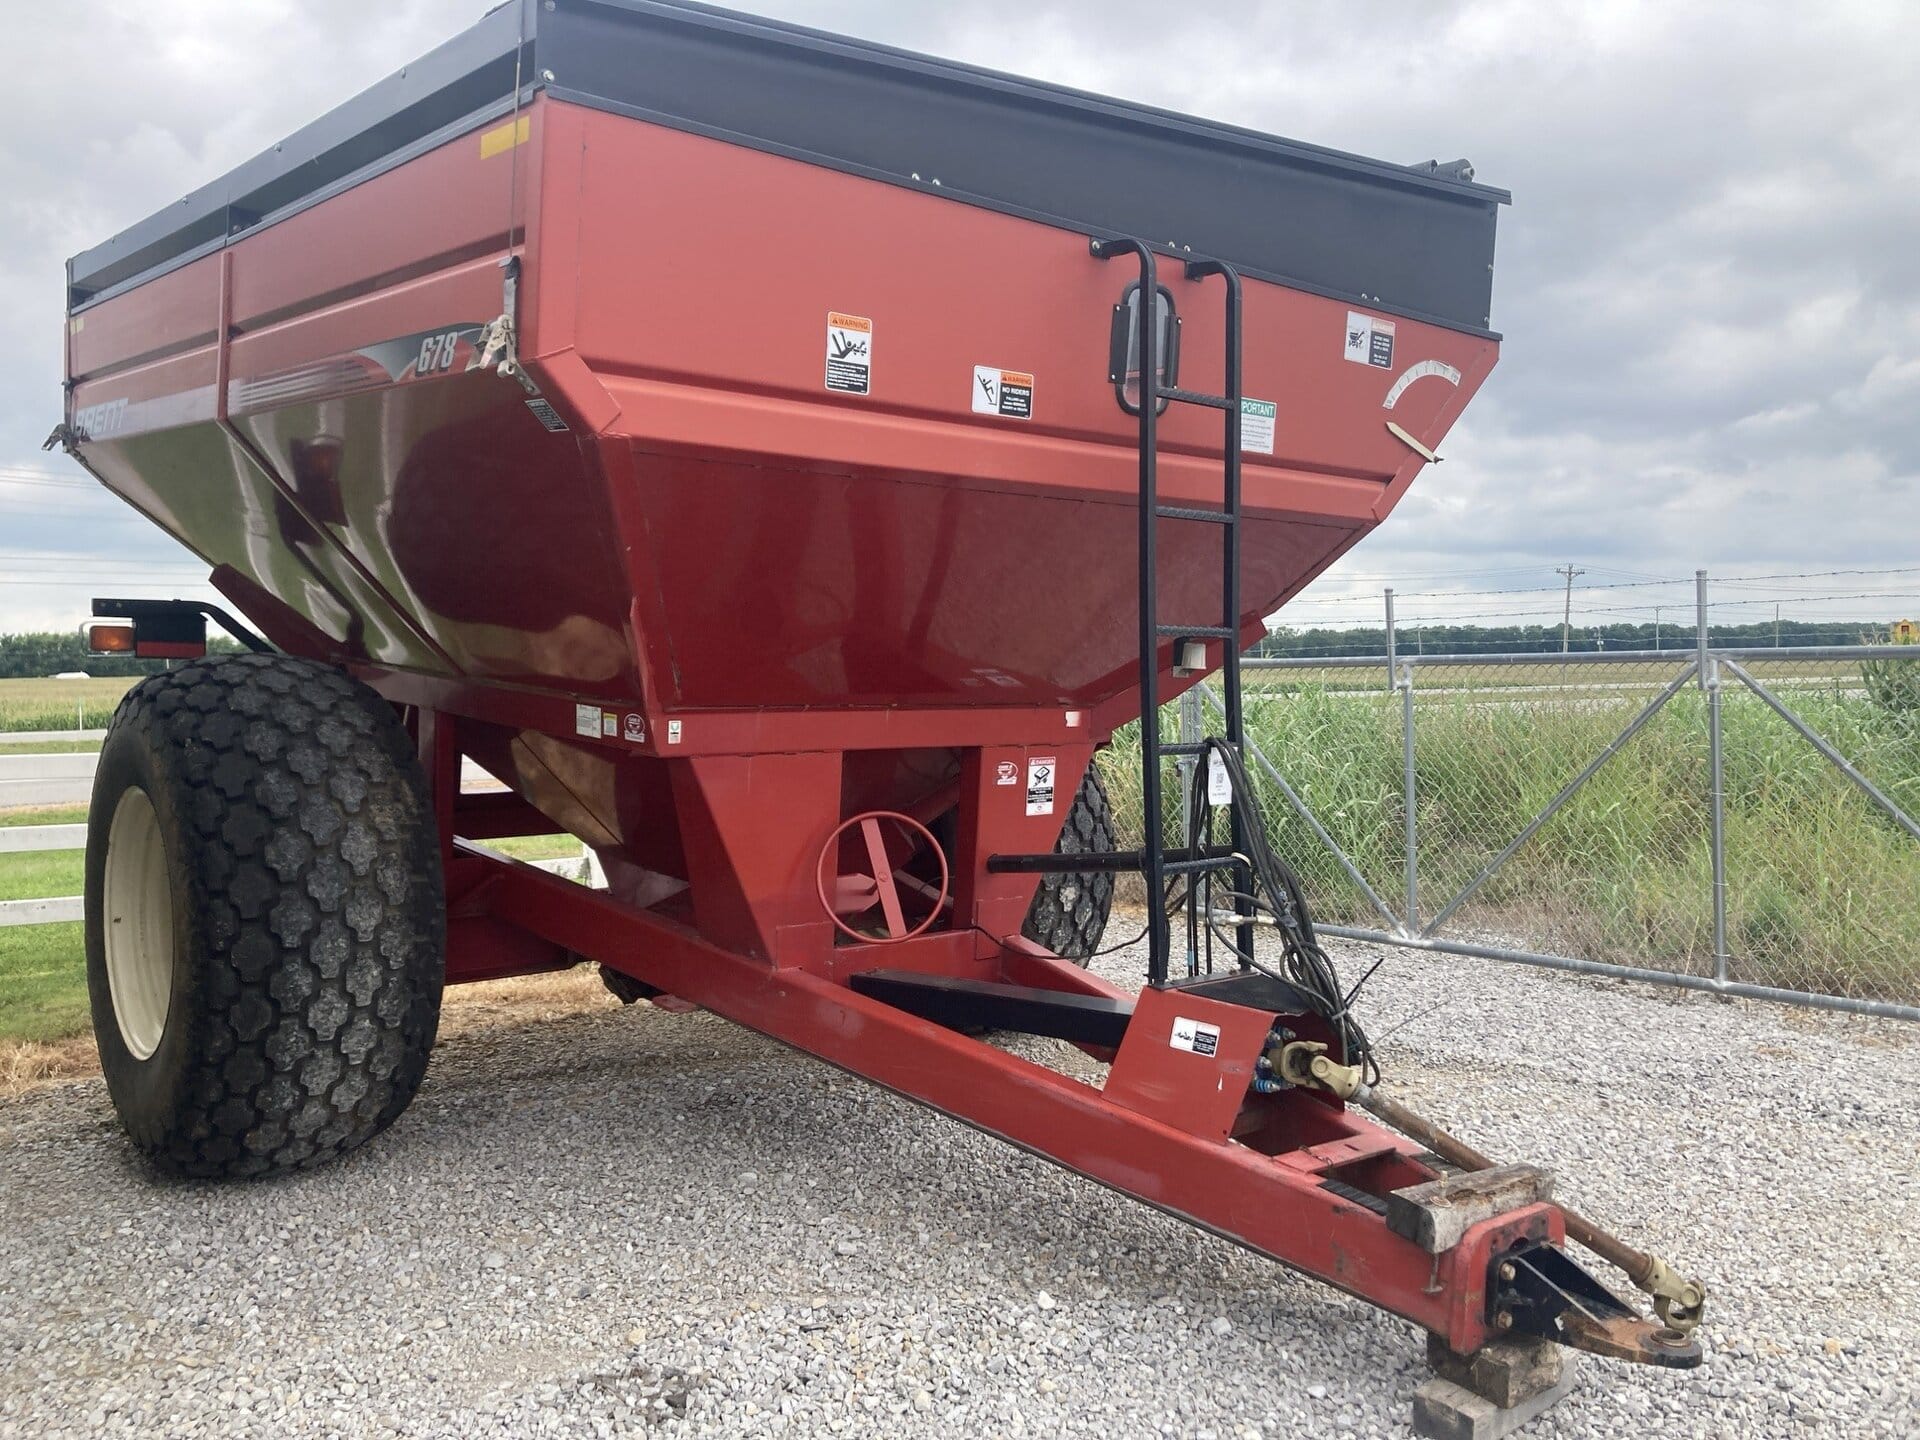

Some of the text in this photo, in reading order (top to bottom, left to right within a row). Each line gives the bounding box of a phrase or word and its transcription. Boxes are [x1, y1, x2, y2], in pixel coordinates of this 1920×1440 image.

[839, 318, 869, 330] WARNING
[417, 331, 458, 373] 678
[1241, 400, 1274, 417] PORTANT
